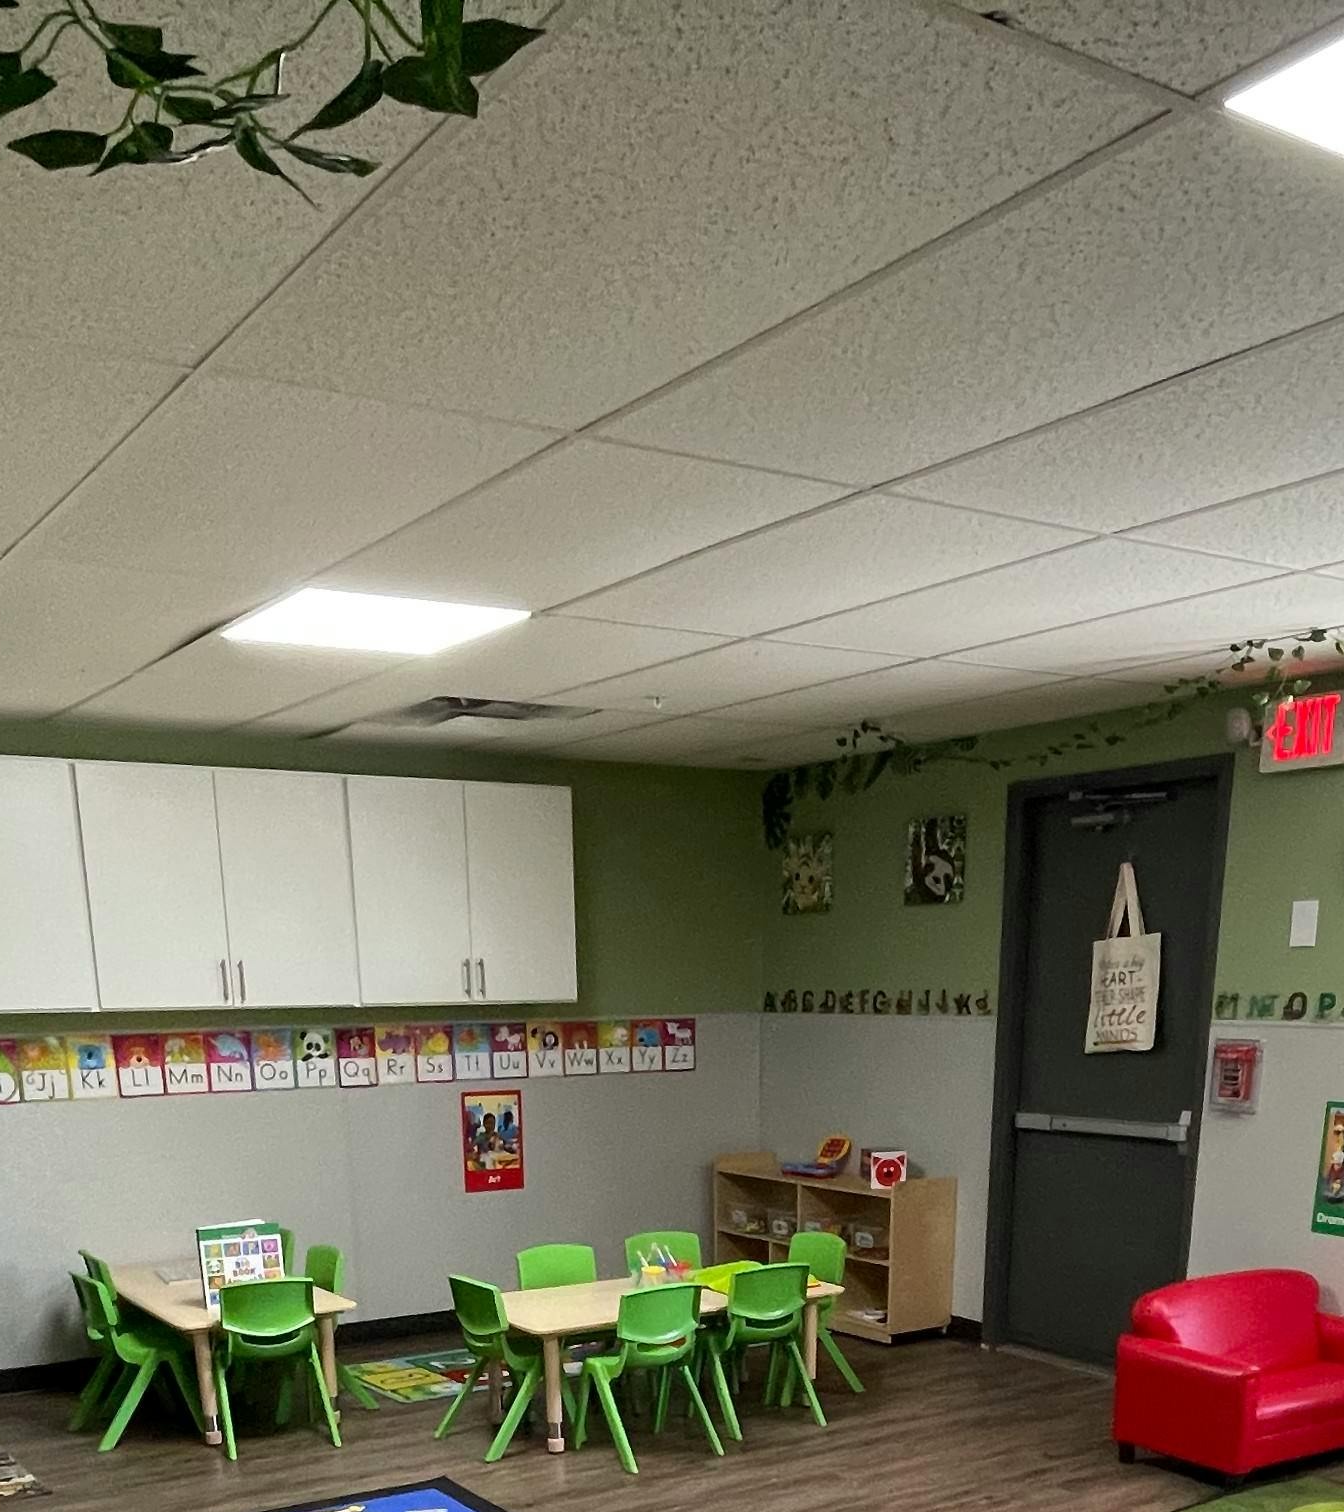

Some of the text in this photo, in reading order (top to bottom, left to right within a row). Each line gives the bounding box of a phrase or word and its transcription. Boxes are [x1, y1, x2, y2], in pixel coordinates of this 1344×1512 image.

[1273, 693, 1341, 762] EXIT
[1093, 1004, 1147, 1028] little
[35, 1073, 56, 1100] Jj
[81, 1070, 107, 1090] Kk
[131, 1068, 150, 1087] Ll
[169, 1068, 204, 1086] Mm
[217, 1065, 244, 1083] Nn
[259, 1063, 289, 1082] Oo
[305, 1062, 328, 1087] Pp
[343, 1060, 373, 1084] Qq
[386, 1058, 405, 1075] Rr
[425, 1057, 444, 1074] Ss
[499, 1053, 521, 1071] Uu
[535, 1053, 556, 1070] Vv
[605, 1050, 624, 1067] Xx
[638, 1050, 656, 1070] Yy
[671, 1047, 690, 1063] Zz
